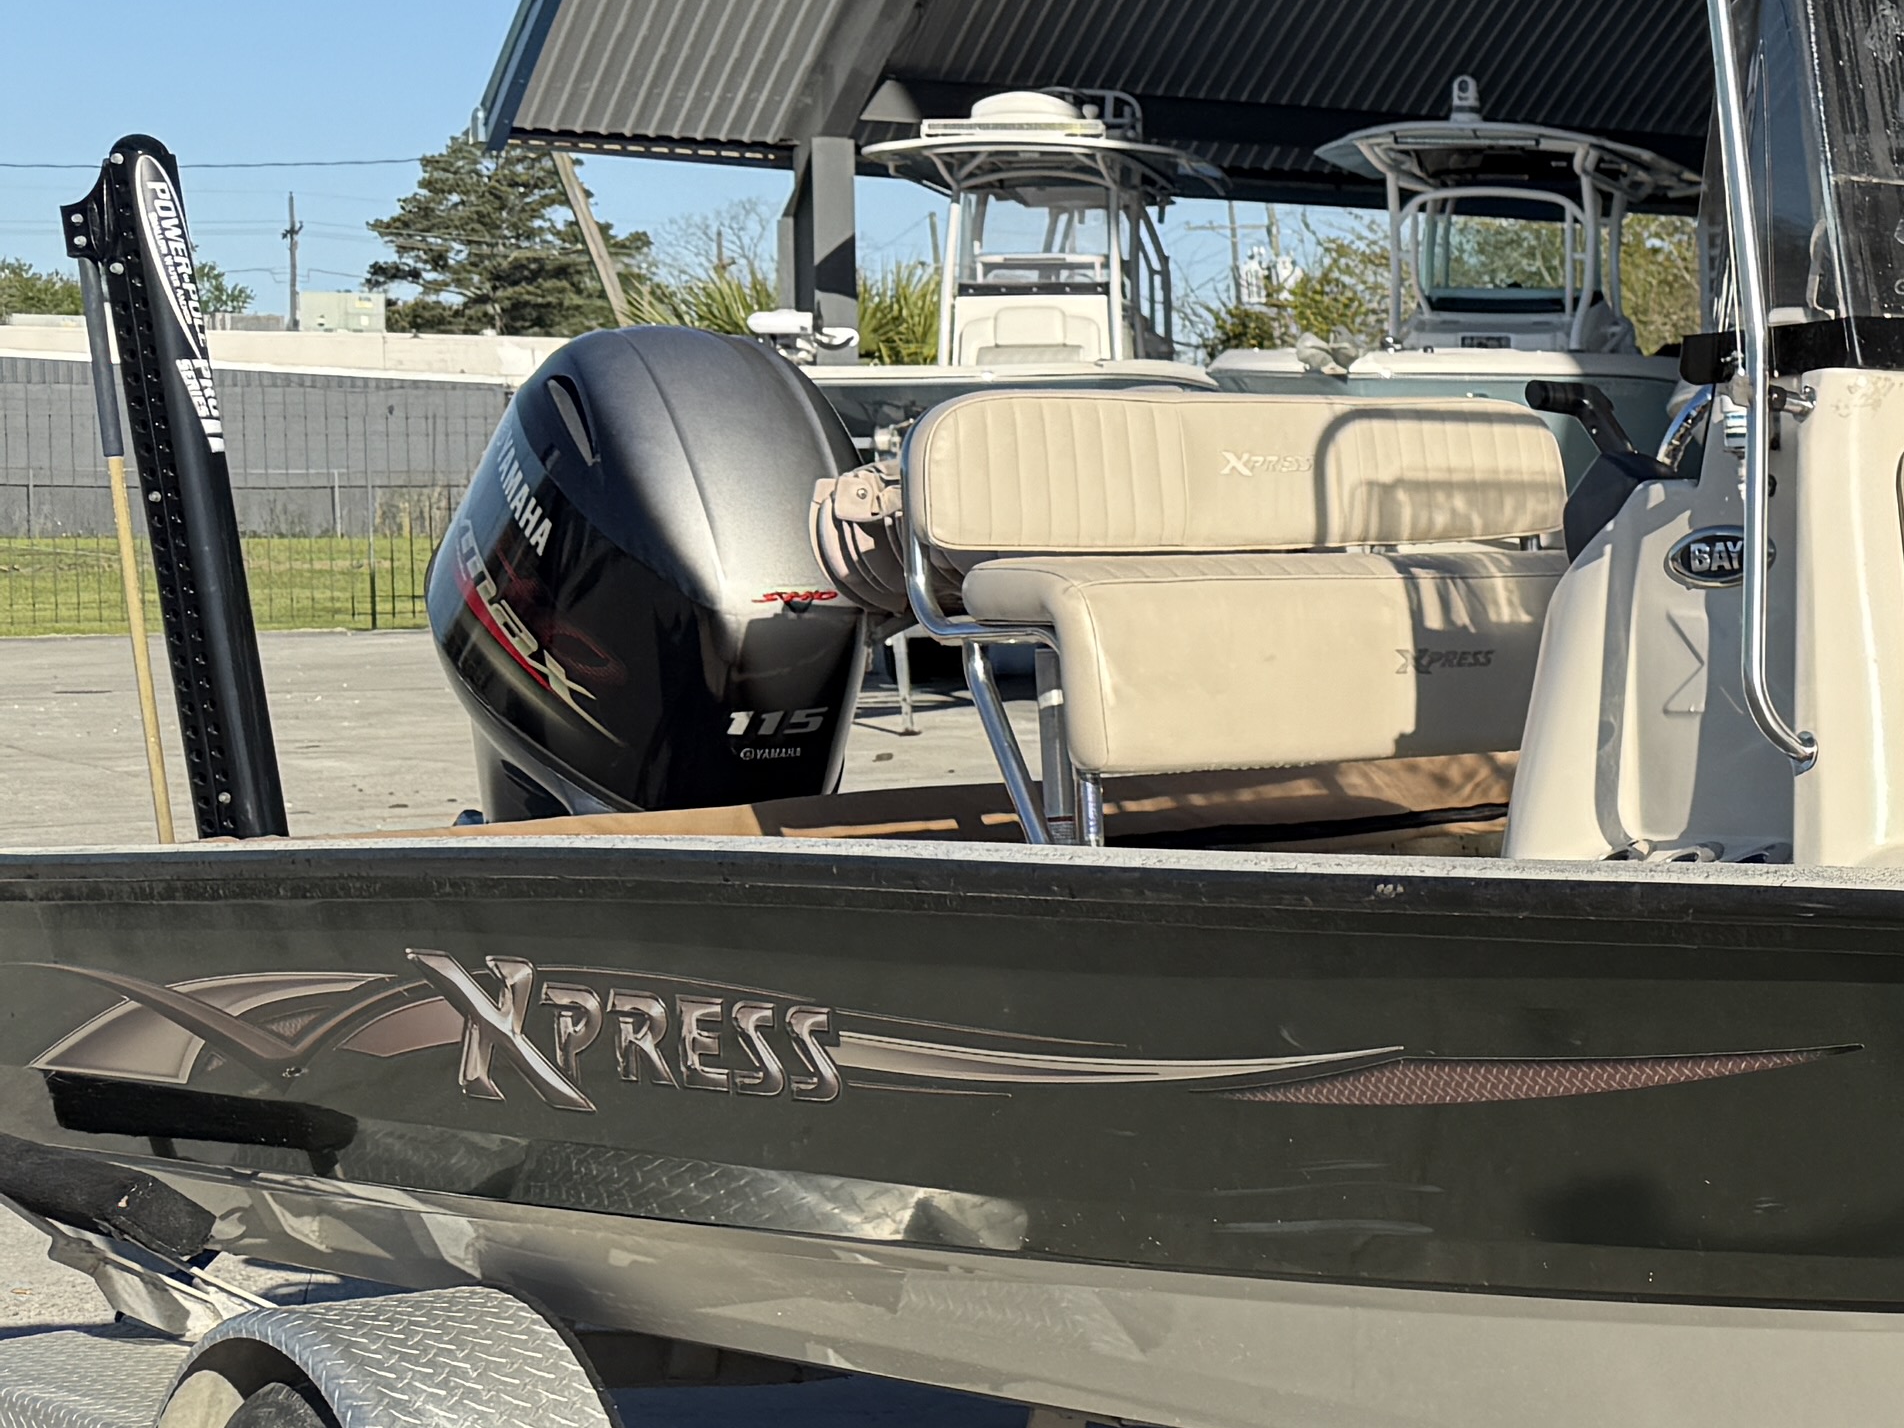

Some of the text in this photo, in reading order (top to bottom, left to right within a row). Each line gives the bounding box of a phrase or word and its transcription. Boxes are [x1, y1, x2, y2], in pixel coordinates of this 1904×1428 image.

[146, 179, 208, 348] POWER-POLE
[175, 358, 210, 419] SERIES
[1219, 450, 1316, 477] XPRESS
[497, 437, 553, 557] YAMAHA
[1689, 539, 1745, 572] BAY
[1395, 647, 1496, 675] XPRESS
[726, 706, 829, 736] 115
[756, 747, 802, 760] YAMAHA
[405, 946, 843, 1113] XPRESS
